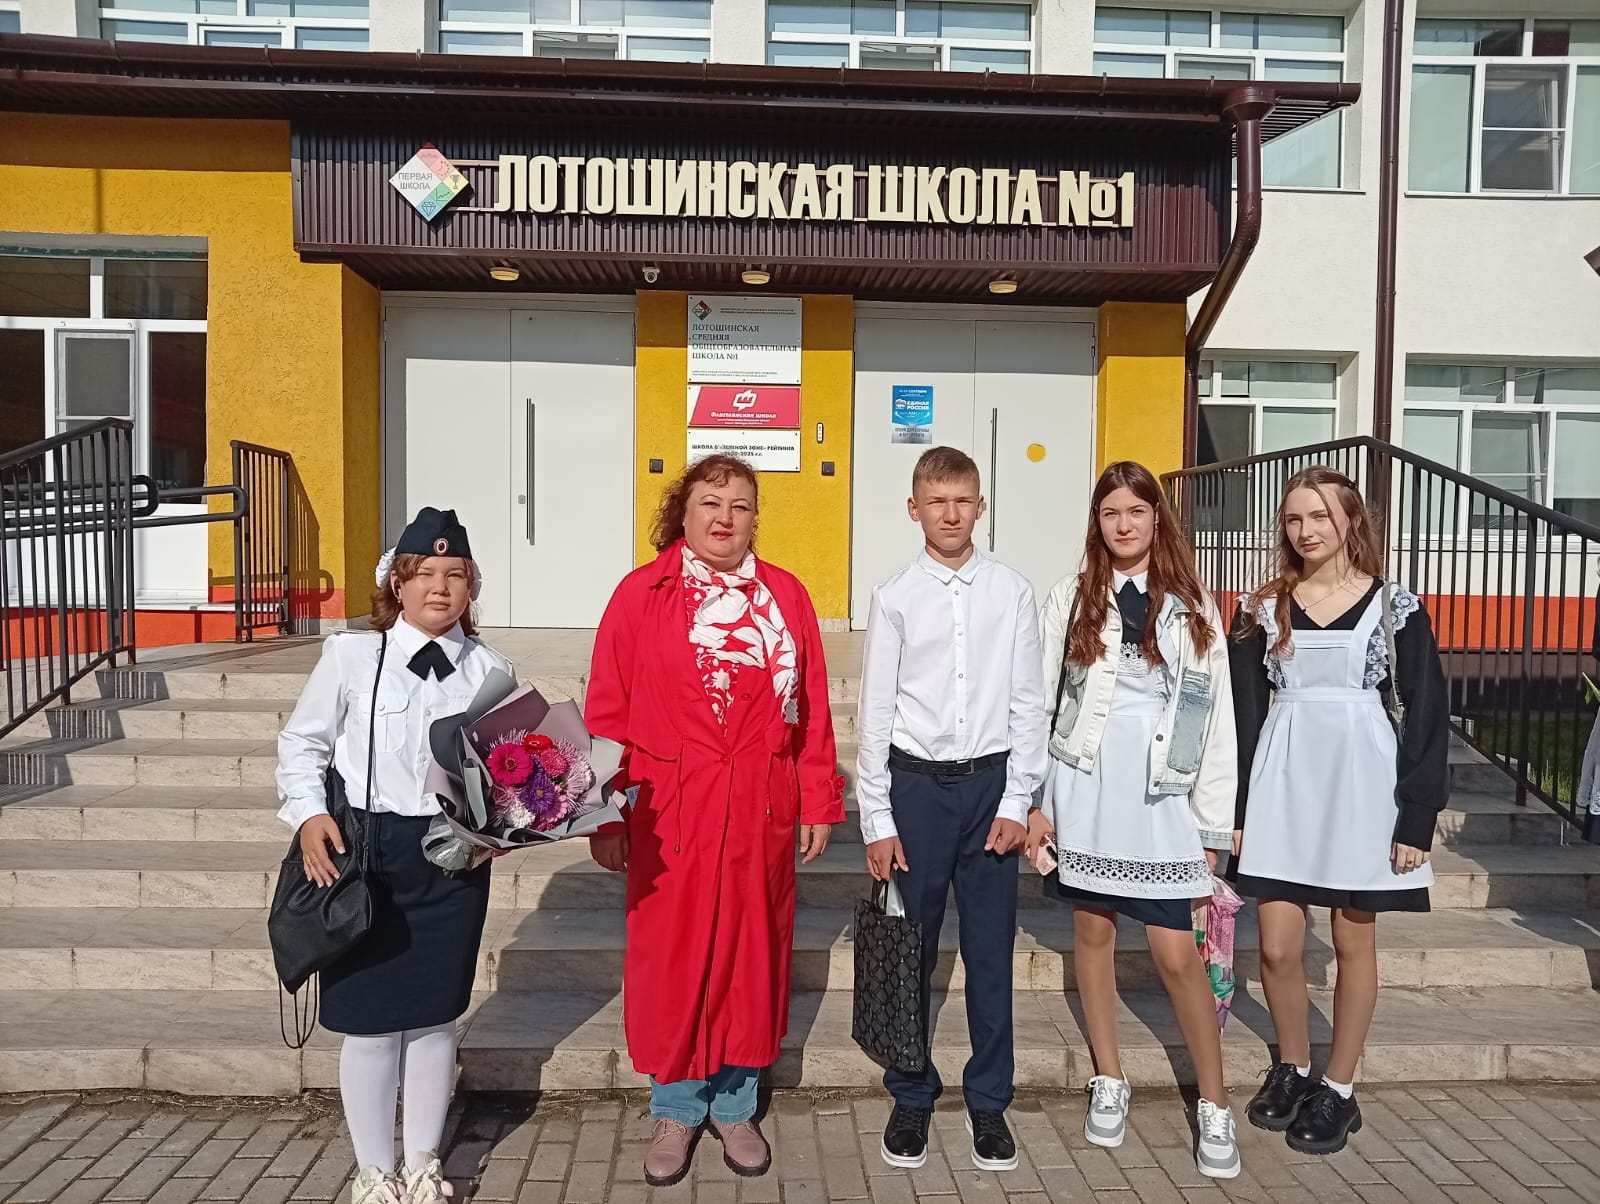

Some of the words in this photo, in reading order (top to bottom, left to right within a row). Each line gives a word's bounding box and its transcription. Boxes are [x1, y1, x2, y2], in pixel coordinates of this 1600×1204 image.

[398, 172, 433, 181] ПЕРВАЯ
[400, 182, 431, 190] ШКОЛА
[494, 154, 854, 221] ЛОТОШИНСКАЯ
[868, 165, 1043, 225] ШКОЛА
[1059, 170, 1135, 228] №1
[692, 324, 760, 333] ЛОТОШИНСКАЯ
[692, 333, 730, 341] СРЕДНЯЯ
[692, 343, 798, 352] ОБЩЕОБРАЗОВАТЕЛЬНАЯ
[692, 352, 725, 360] ШКОЛА
[726, 353, 739, 361] №1
